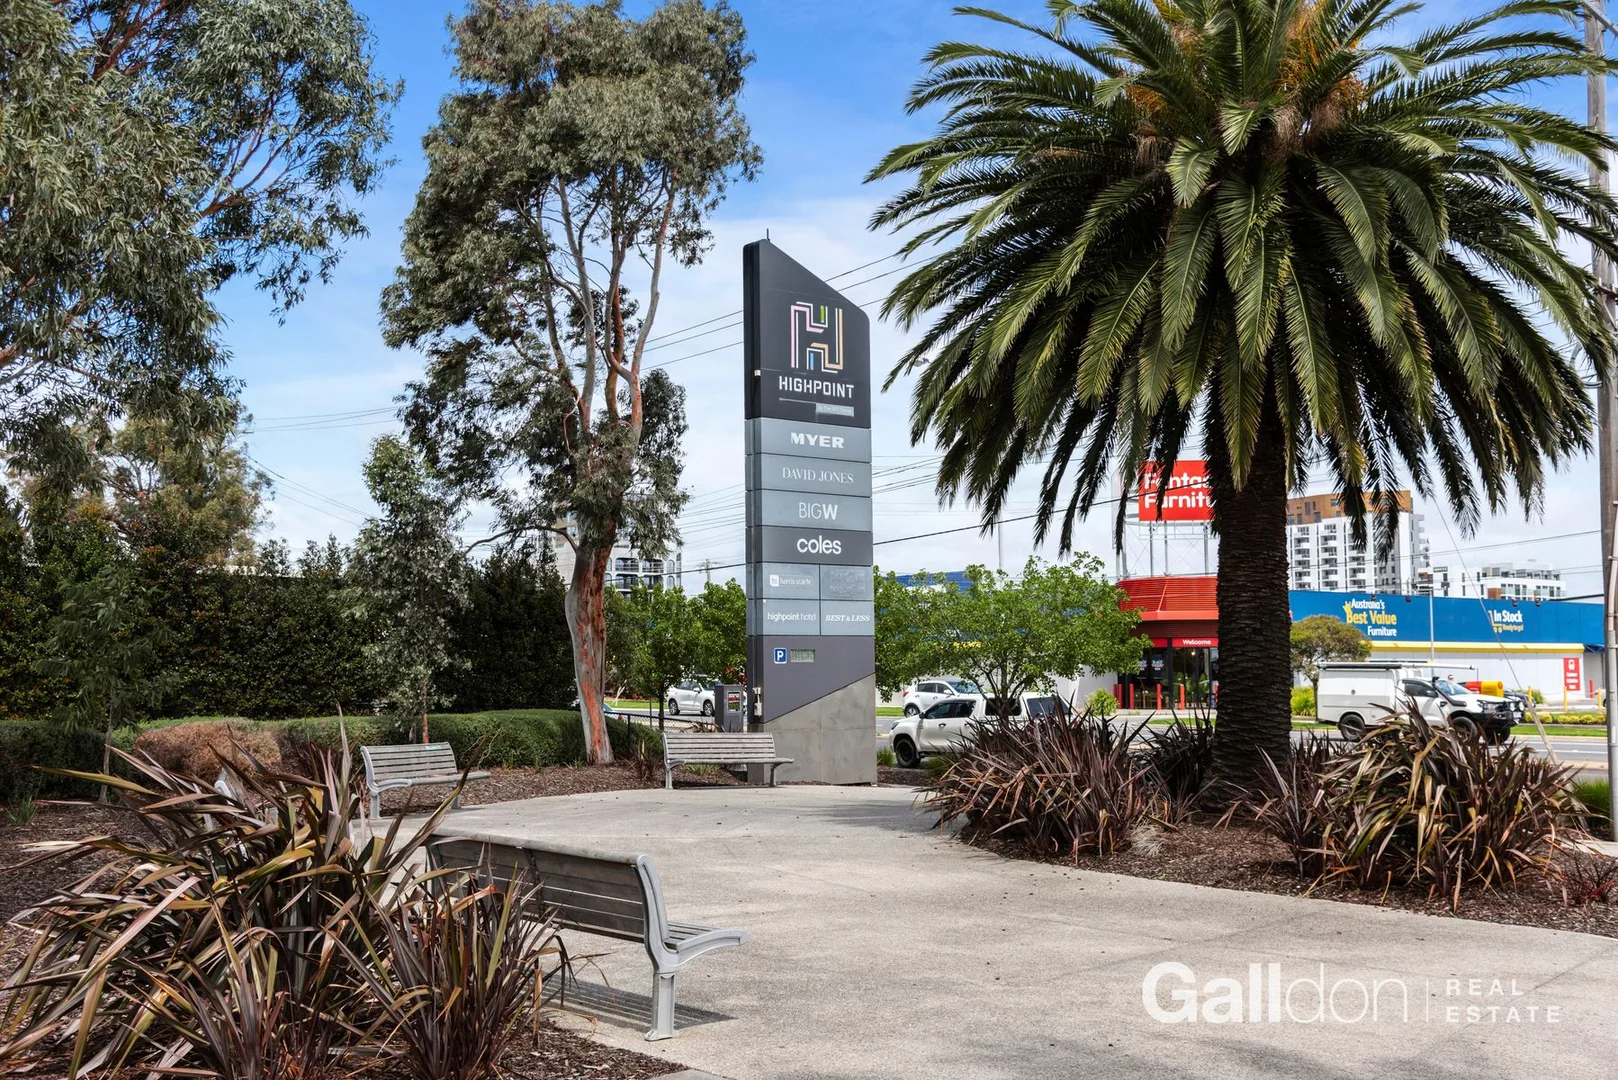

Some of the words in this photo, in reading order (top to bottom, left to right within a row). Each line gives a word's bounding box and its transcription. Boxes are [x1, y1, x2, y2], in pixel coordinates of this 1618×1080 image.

[779, 376, 854, 398] HIGHPOINT
[790, 432, 844, 449] MYER
[782, 467, 816, 481] DAVID
[819, 471, 854, 484] JONES
[797, 535, 842, 555] coles
[767, 612, 799, 622] highpoint
[800, 612, 817, 621] hotel
[825, 614, 846, 622] BEST
[851, 614, 871, 622] LESS
[1346, 610, 1368, 624] Best
[1369, 610, 1397, 625] Value
[1493, 609, 1502, 622] In
[1502, 609, 1523, 623] Stock
[1367, 626, 1397, 636] Furniture
